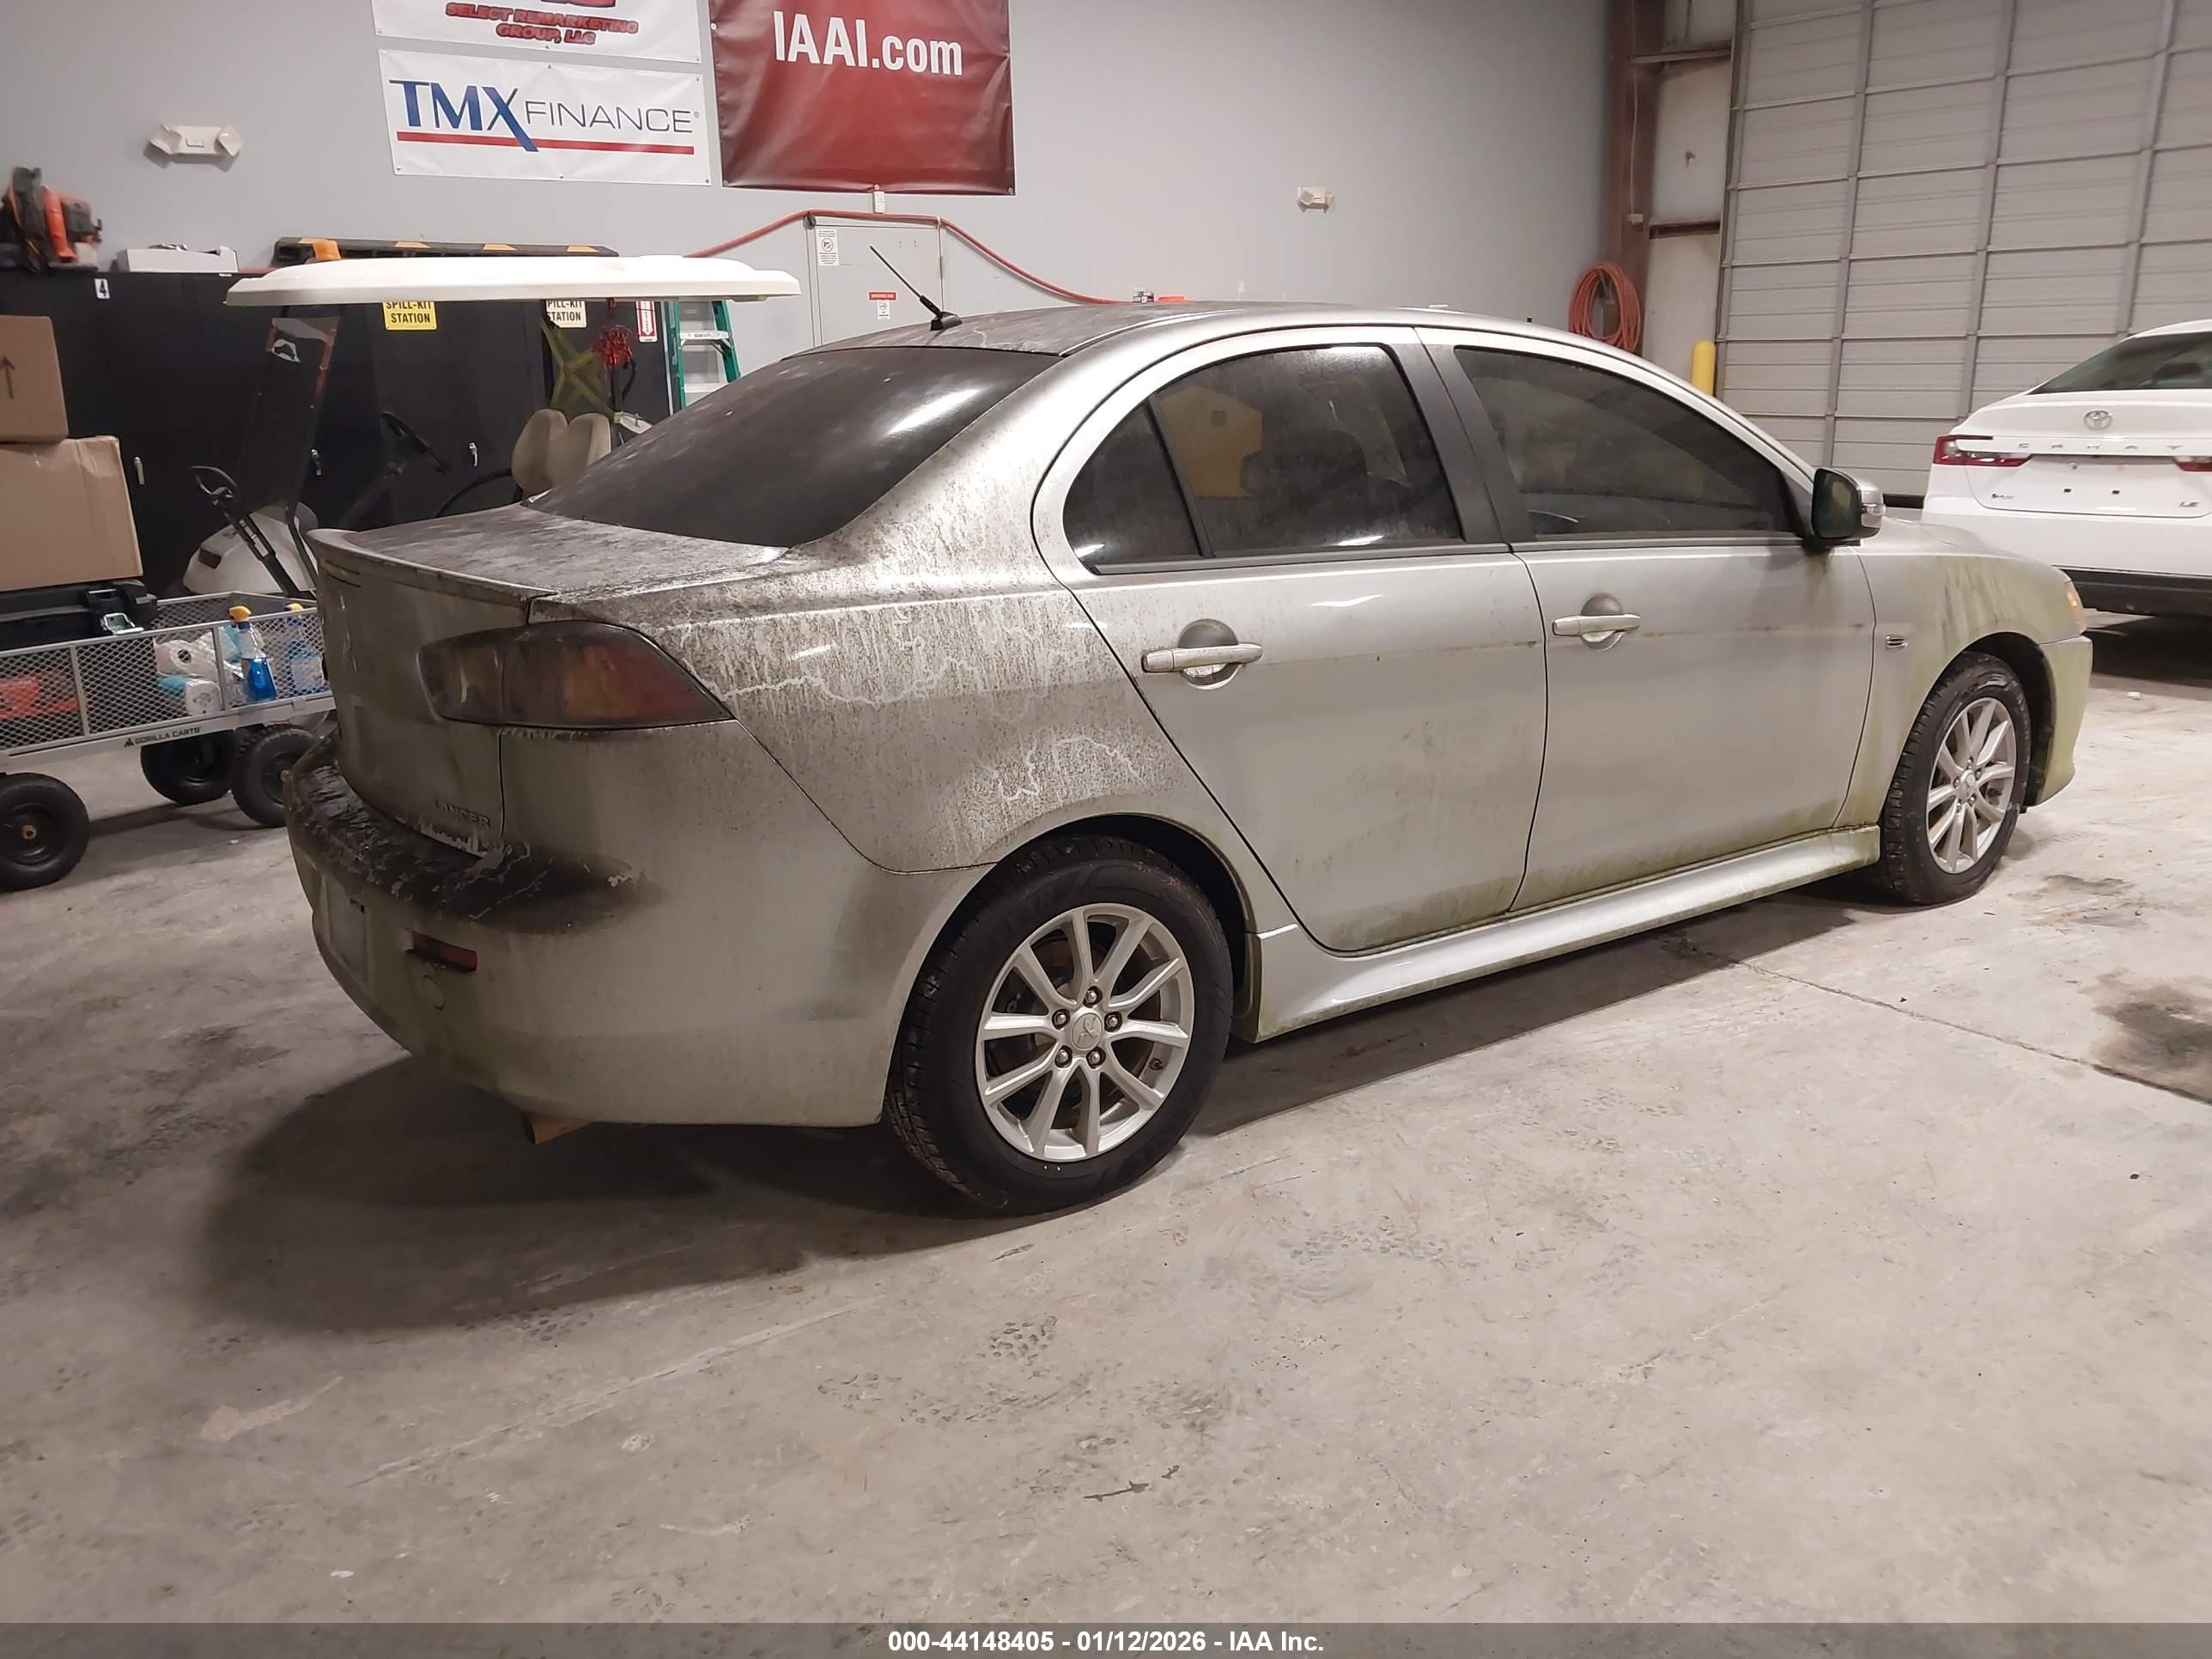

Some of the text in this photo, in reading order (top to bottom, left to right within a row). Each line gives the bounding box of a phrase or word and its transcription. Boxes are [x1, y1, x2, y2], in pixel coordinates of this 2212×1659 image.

[446, 3, 639, 33] SELECT REMARKETING
[496, 23, 596, 45] GROUP, LLC
[774, 10, 963, 76] IAAI.com
[389, 79, 693, 152] TMX FINANCE
[99, 280, 107, 298] 4
[386, 301, 432, 310] SPILL-KIT
[547, 300, 582, 308] PILL-KIT
[391, 313, 431, 324] STATION
[135, 732, 170, 744] GORILLA
[434, 798, 491, 829] LANCER
